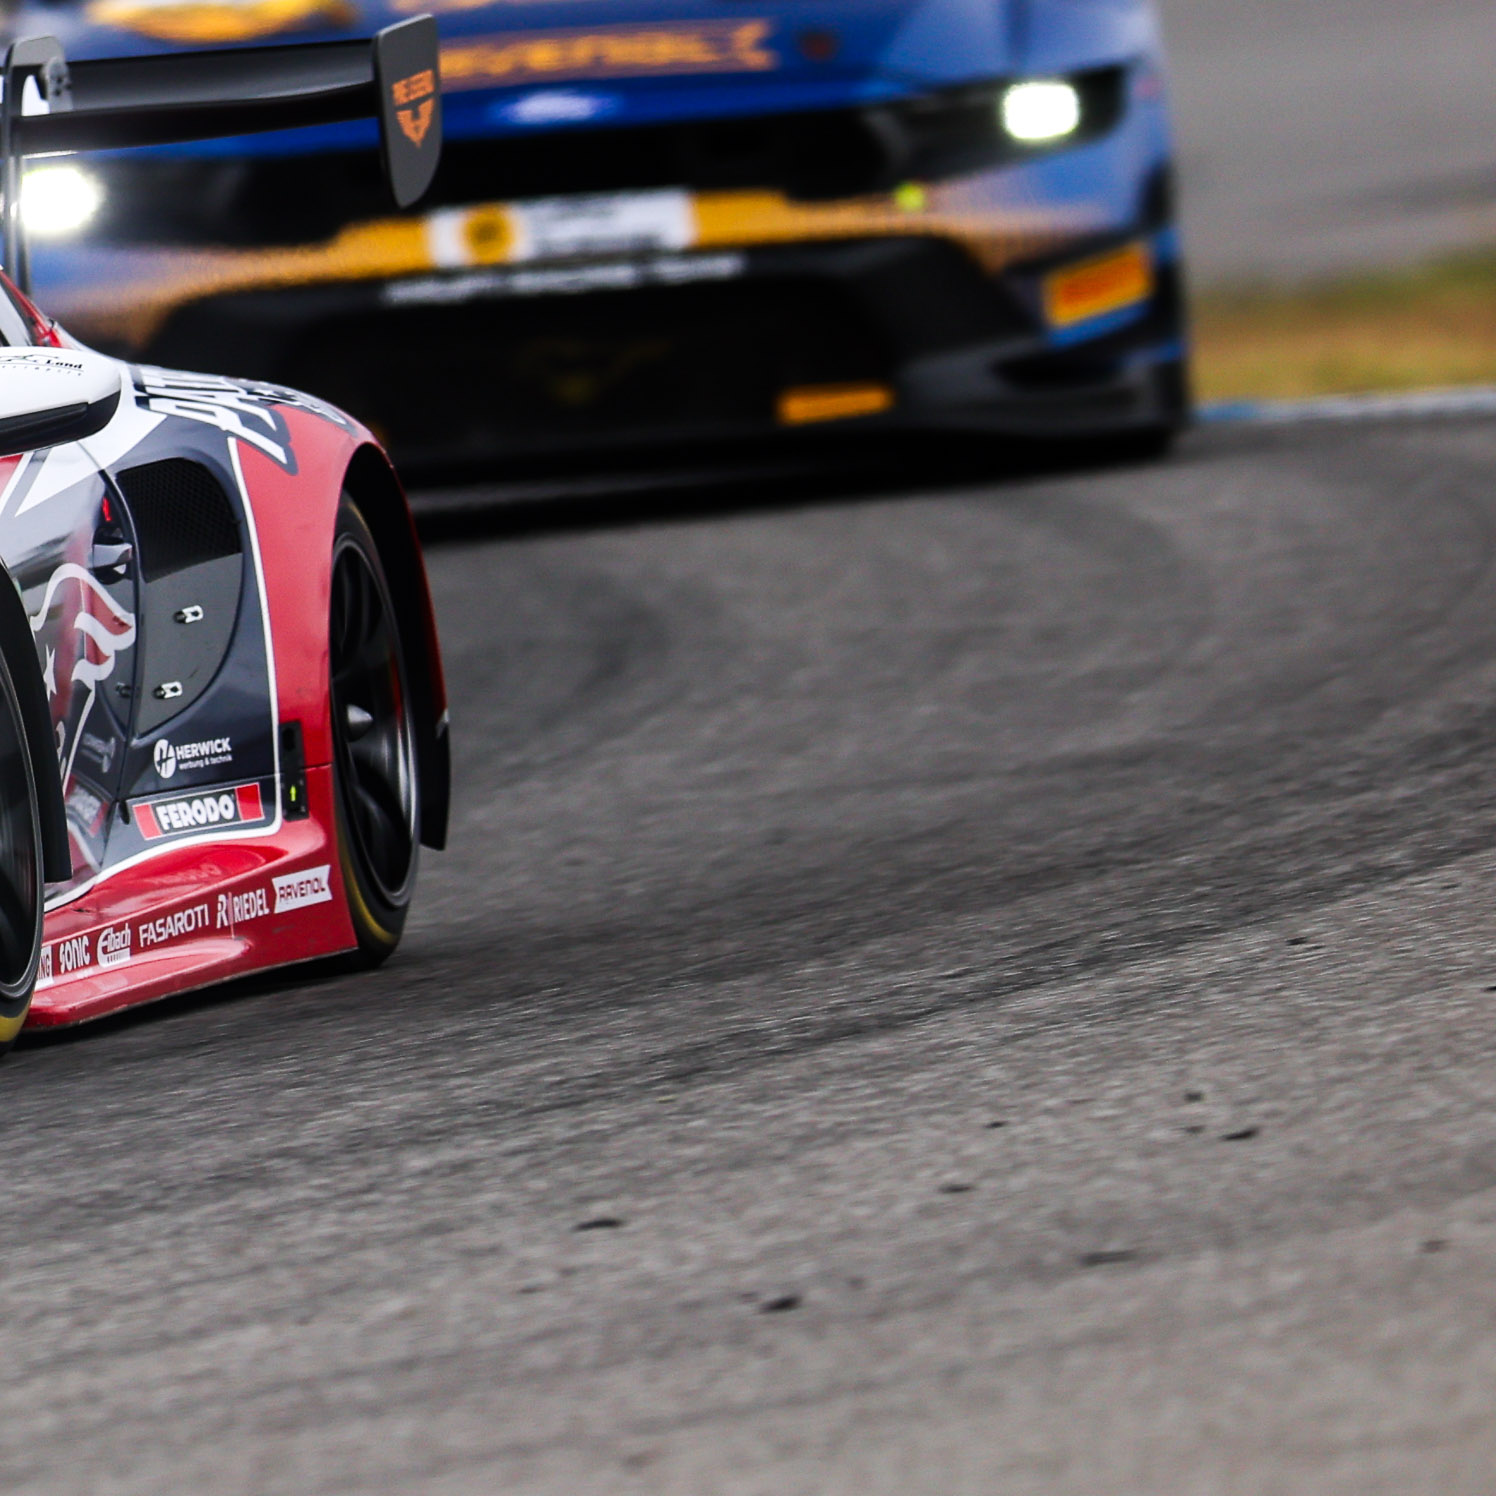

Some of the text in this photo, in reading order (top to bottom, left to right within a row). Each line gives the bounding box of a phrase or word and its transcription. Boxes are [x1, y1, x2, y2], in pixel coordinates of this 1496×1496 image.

[175, 737, 232, 761] HERWICK
[155, 793, 235, 831] FERODO
[59, 935, 91, 975] SONIC
[96, 922, 132, 968] Eibach
[138, 904, 209, 948] FASAROTI
[232, 888, 271, 924] RIEDEL
[278, 877, 326, 903] RAVENOL
